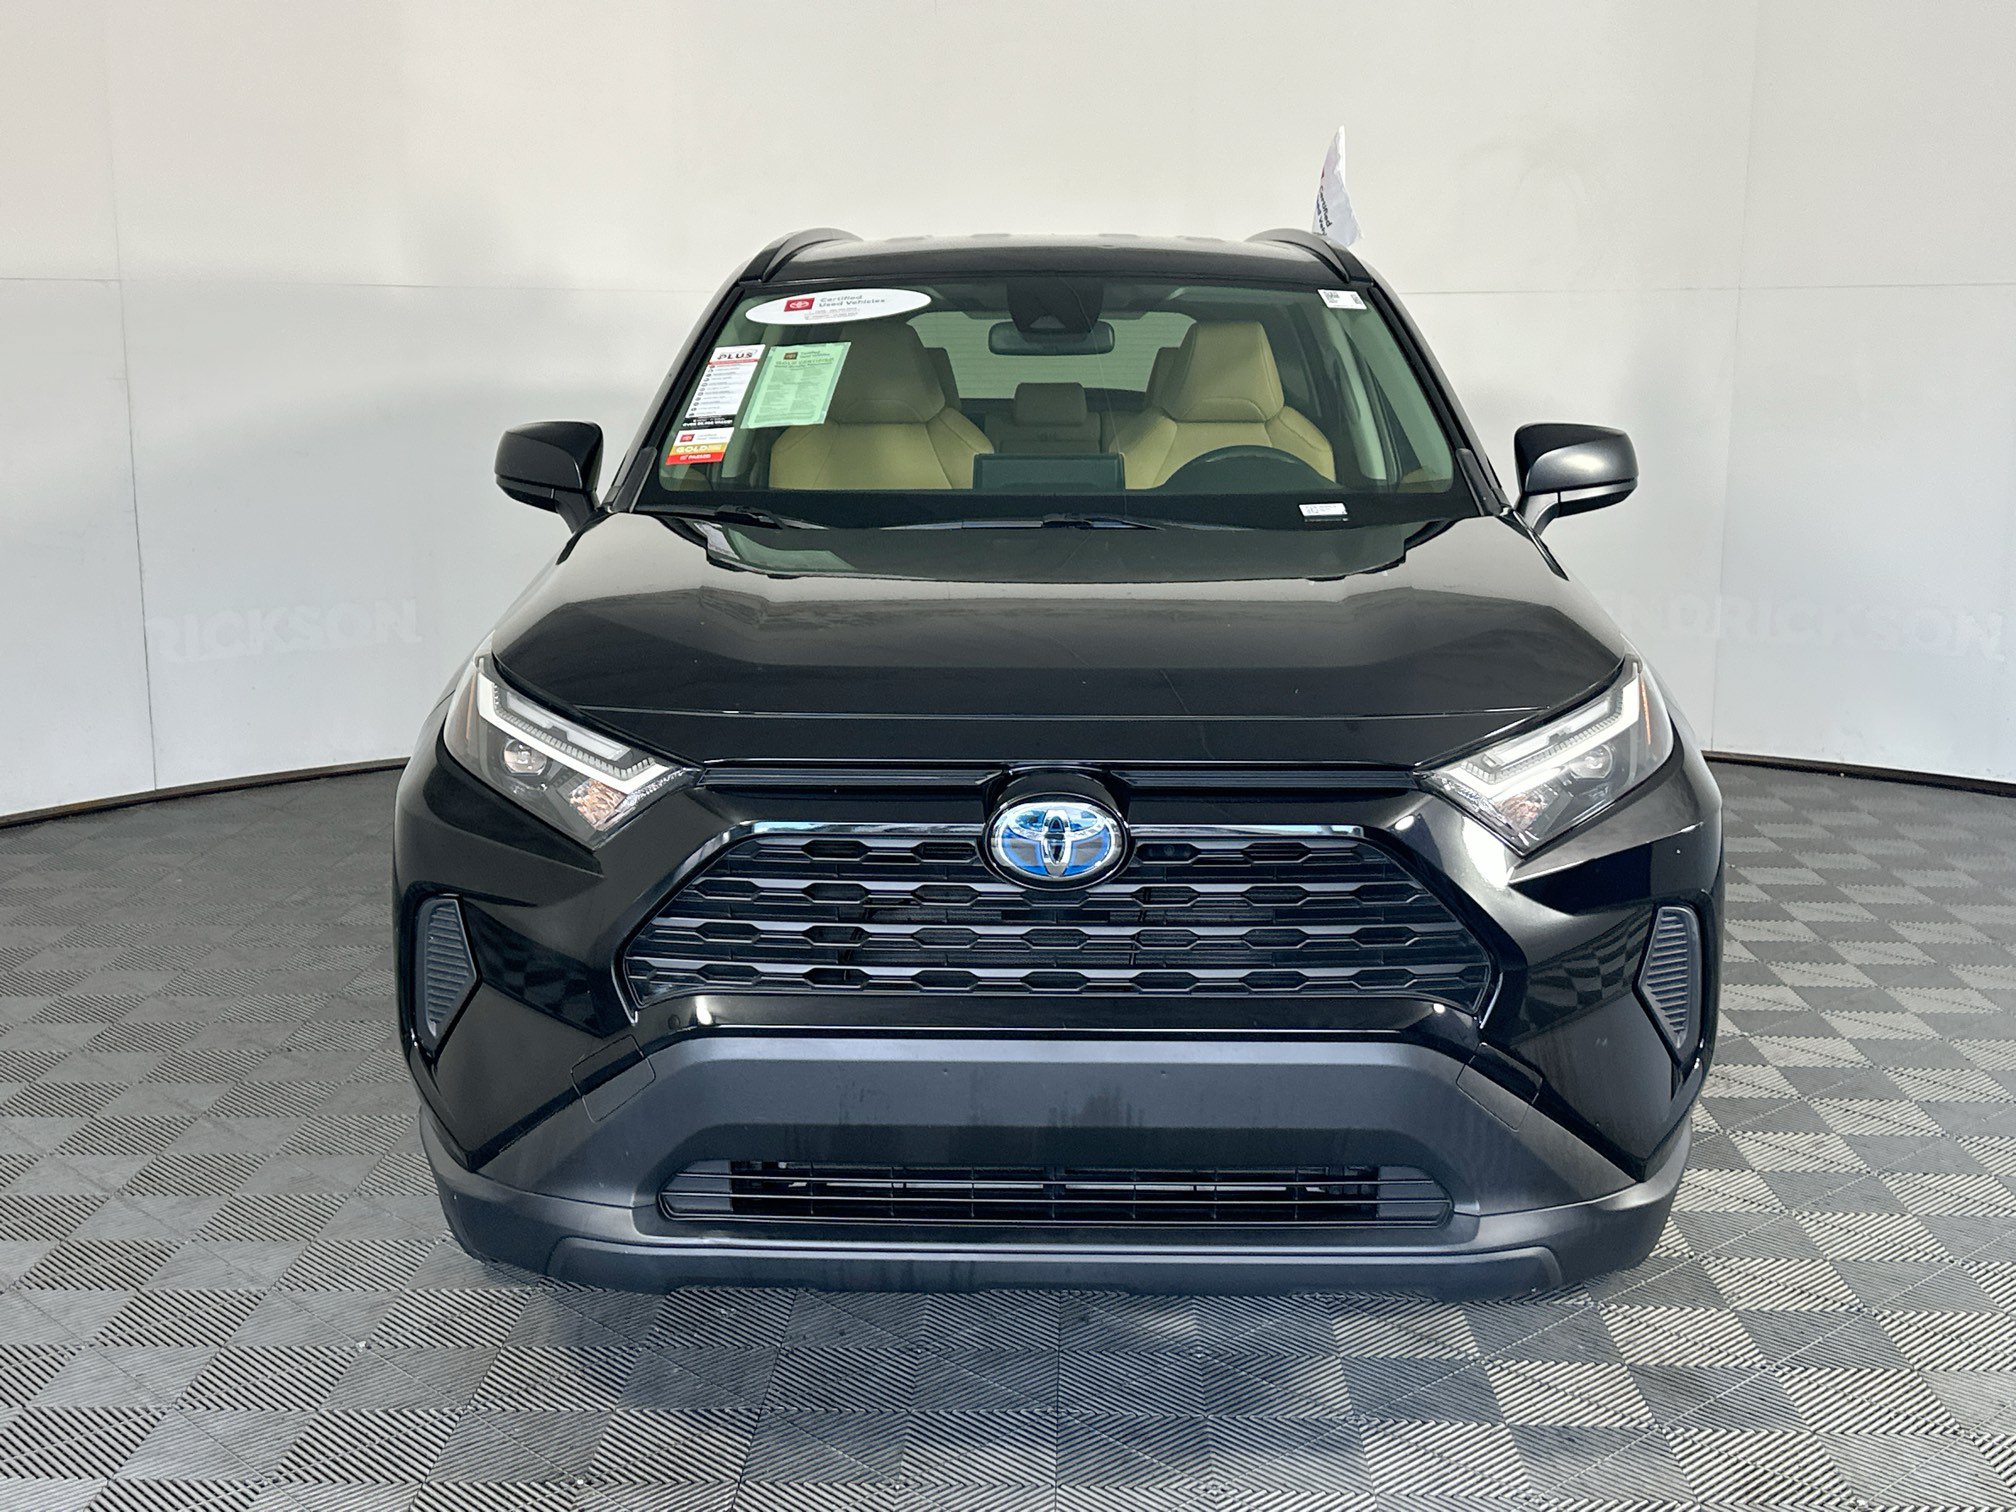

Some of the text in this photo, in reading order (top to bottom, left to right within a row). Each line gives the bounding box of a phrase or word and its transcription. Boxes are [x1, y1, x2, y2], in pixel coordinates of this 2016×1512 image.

[820, 295, 862, 303] Certified
[846, 298, 885, 306] Vehicles
[717, 352, 753, 360] PLUS
[675, 445, 708, 453] GOLD
